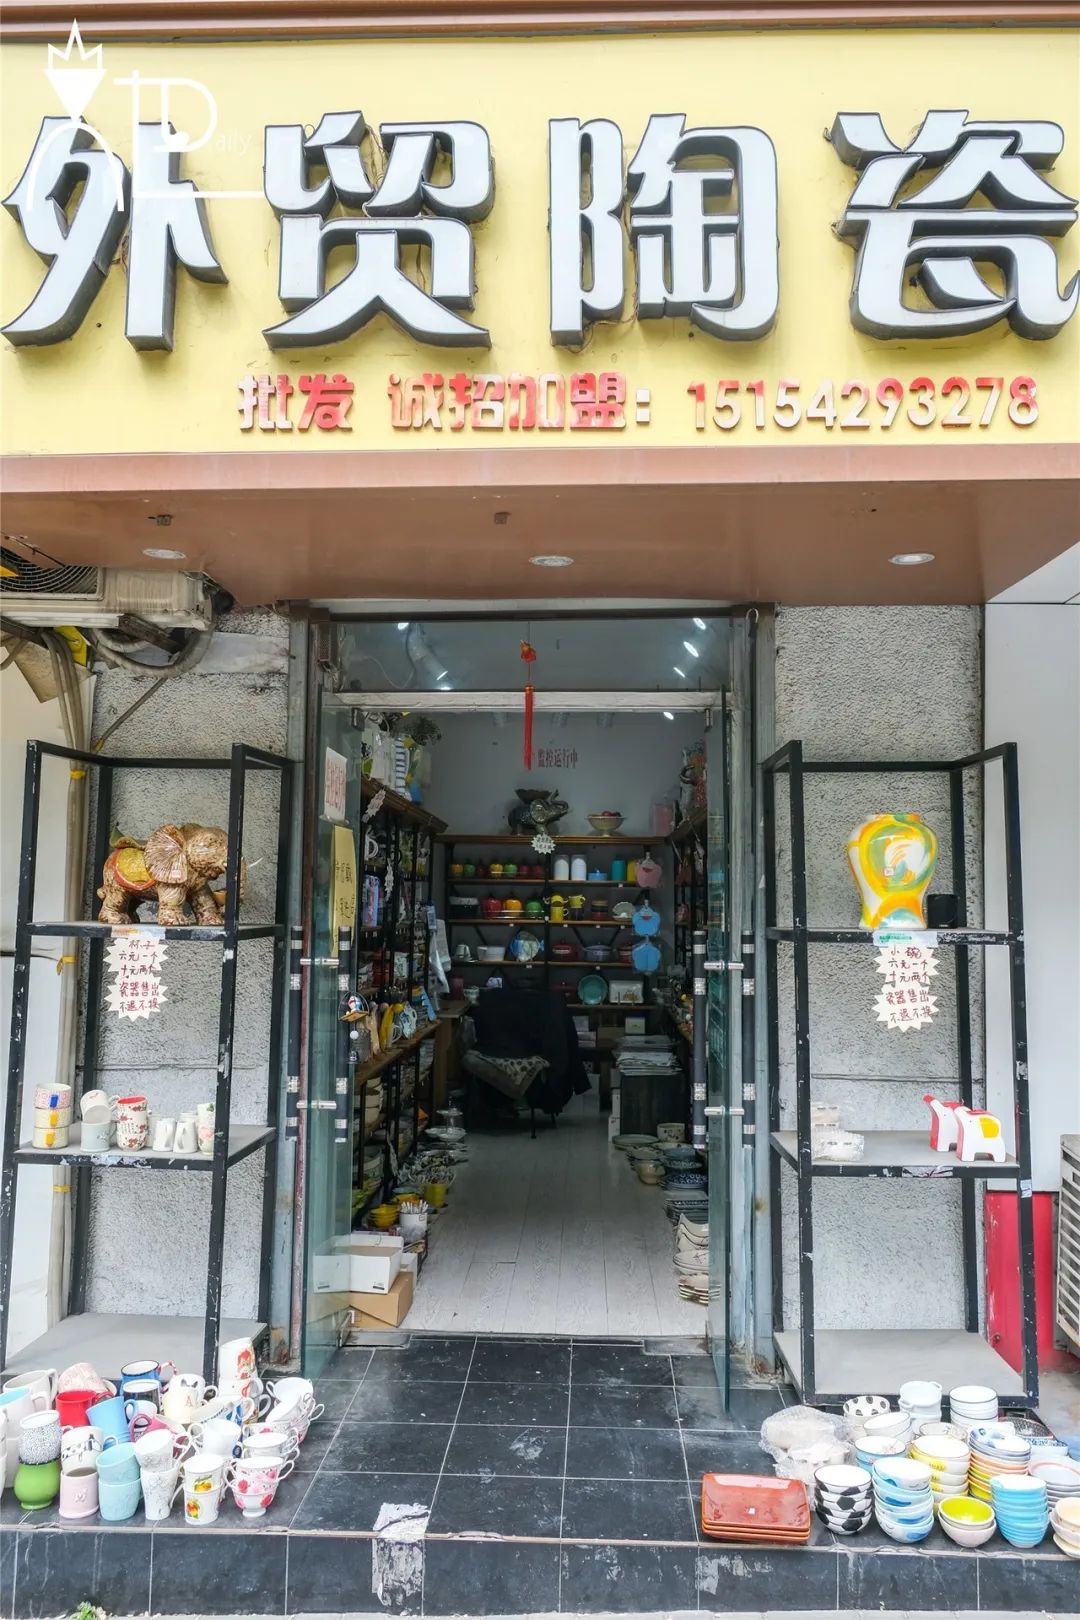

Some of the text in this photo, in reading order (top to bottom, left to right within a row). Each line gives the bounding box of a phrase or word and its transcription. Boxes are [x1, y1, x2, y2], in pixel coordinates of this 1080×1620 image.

[1, 110, 1080, 352] 外贸陶瓷
[238, 373, 354, 432] 批发
[687, 376, 1039, 431] 15154293278
[118, 950, 158, 964] 六元一个
[891, 945, 921, 958] 小碗
[120, 964, 157, 976] 十元两个
[888, 957, 928, 970] 六元一个
[889, 970, 927, 983] 十元两个
[119, 981, 159, 997] 瓷器售出
[886, 988, 929, 1005] 瓷器售出
